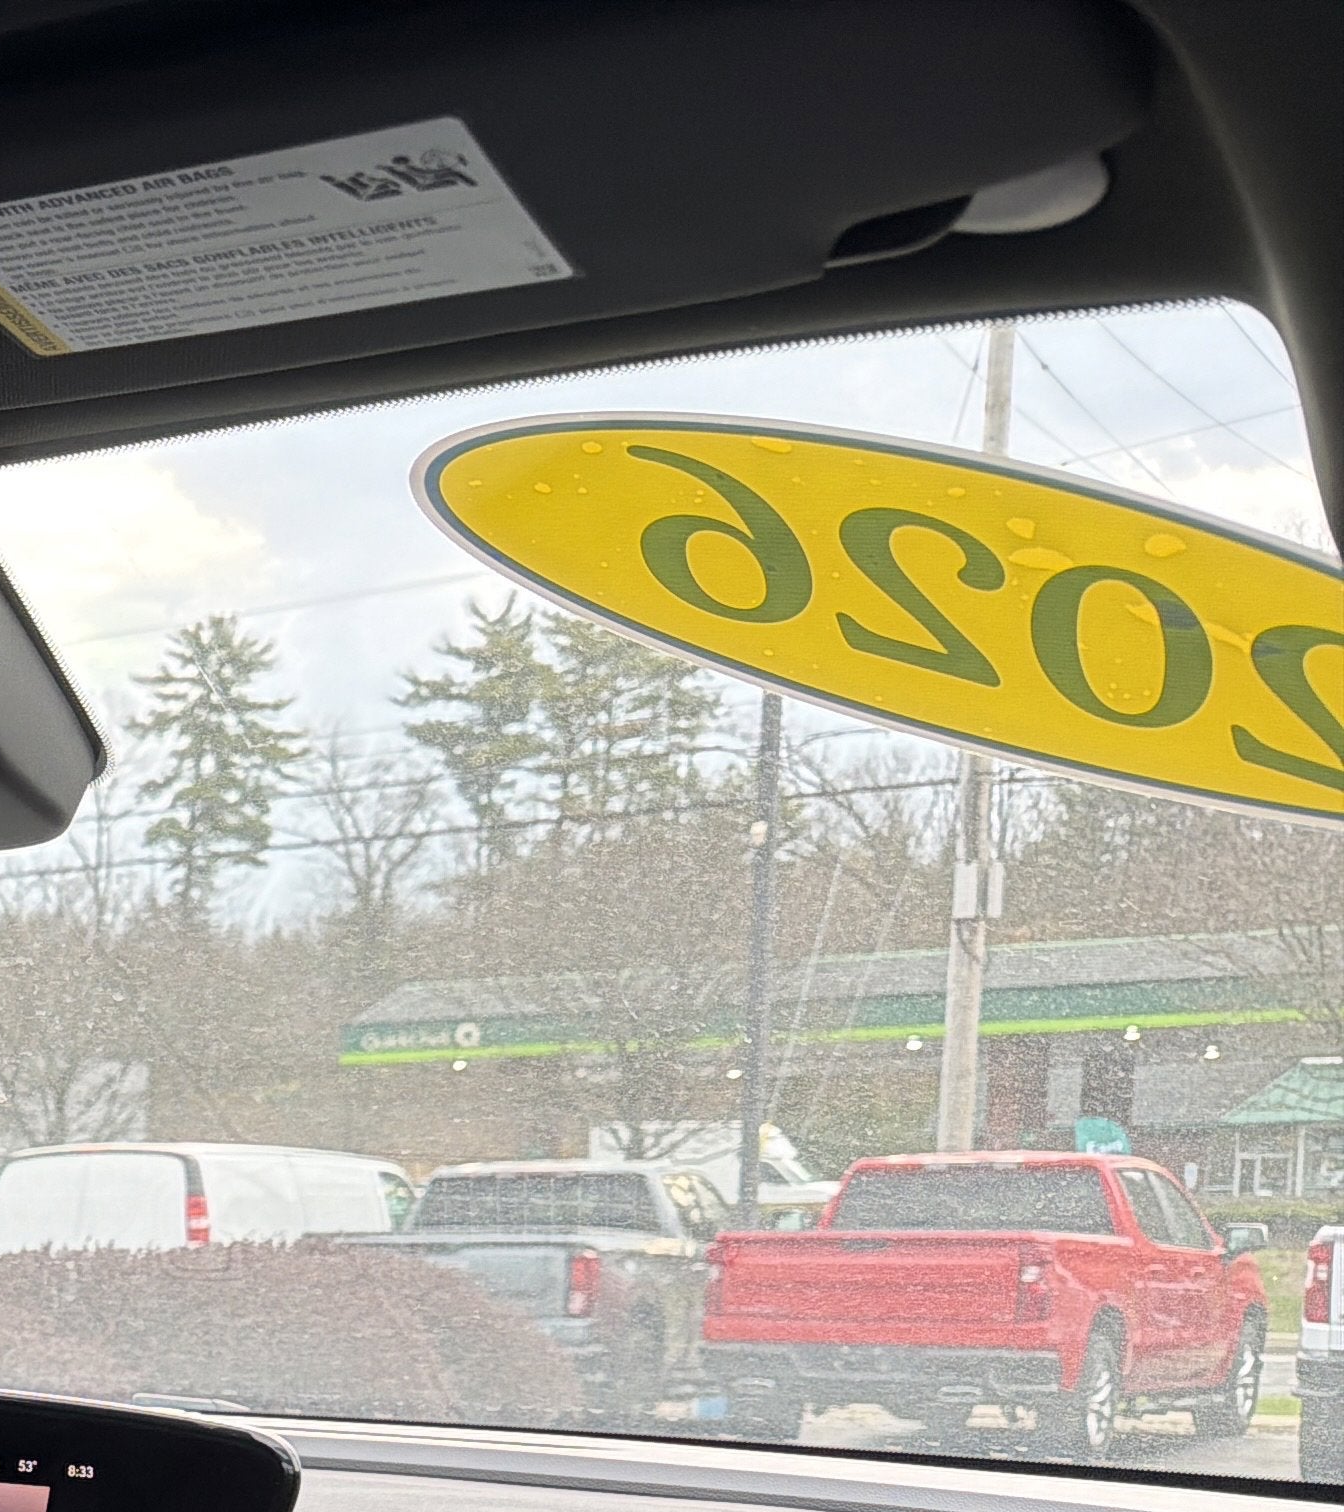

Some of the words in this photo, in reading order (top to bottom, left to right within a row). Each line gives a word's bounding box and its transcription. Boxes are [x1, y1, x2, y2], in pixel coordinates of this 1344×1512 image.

[33, 183, 140, 210] ADVANCED
[137, 176, 177, 191] AIR
[175, 165, 236, 184] BAGS
[59, 271, 107, 286] AVEC
[105, 265, 143, 278] DES
[141, 257, 191, 272] SACS
[189, 238, 307, 265] GONFLABLES
[306, 215, 439, 245] INTELLIGENTS
[67, 1464, 95, 1479] 8:33
